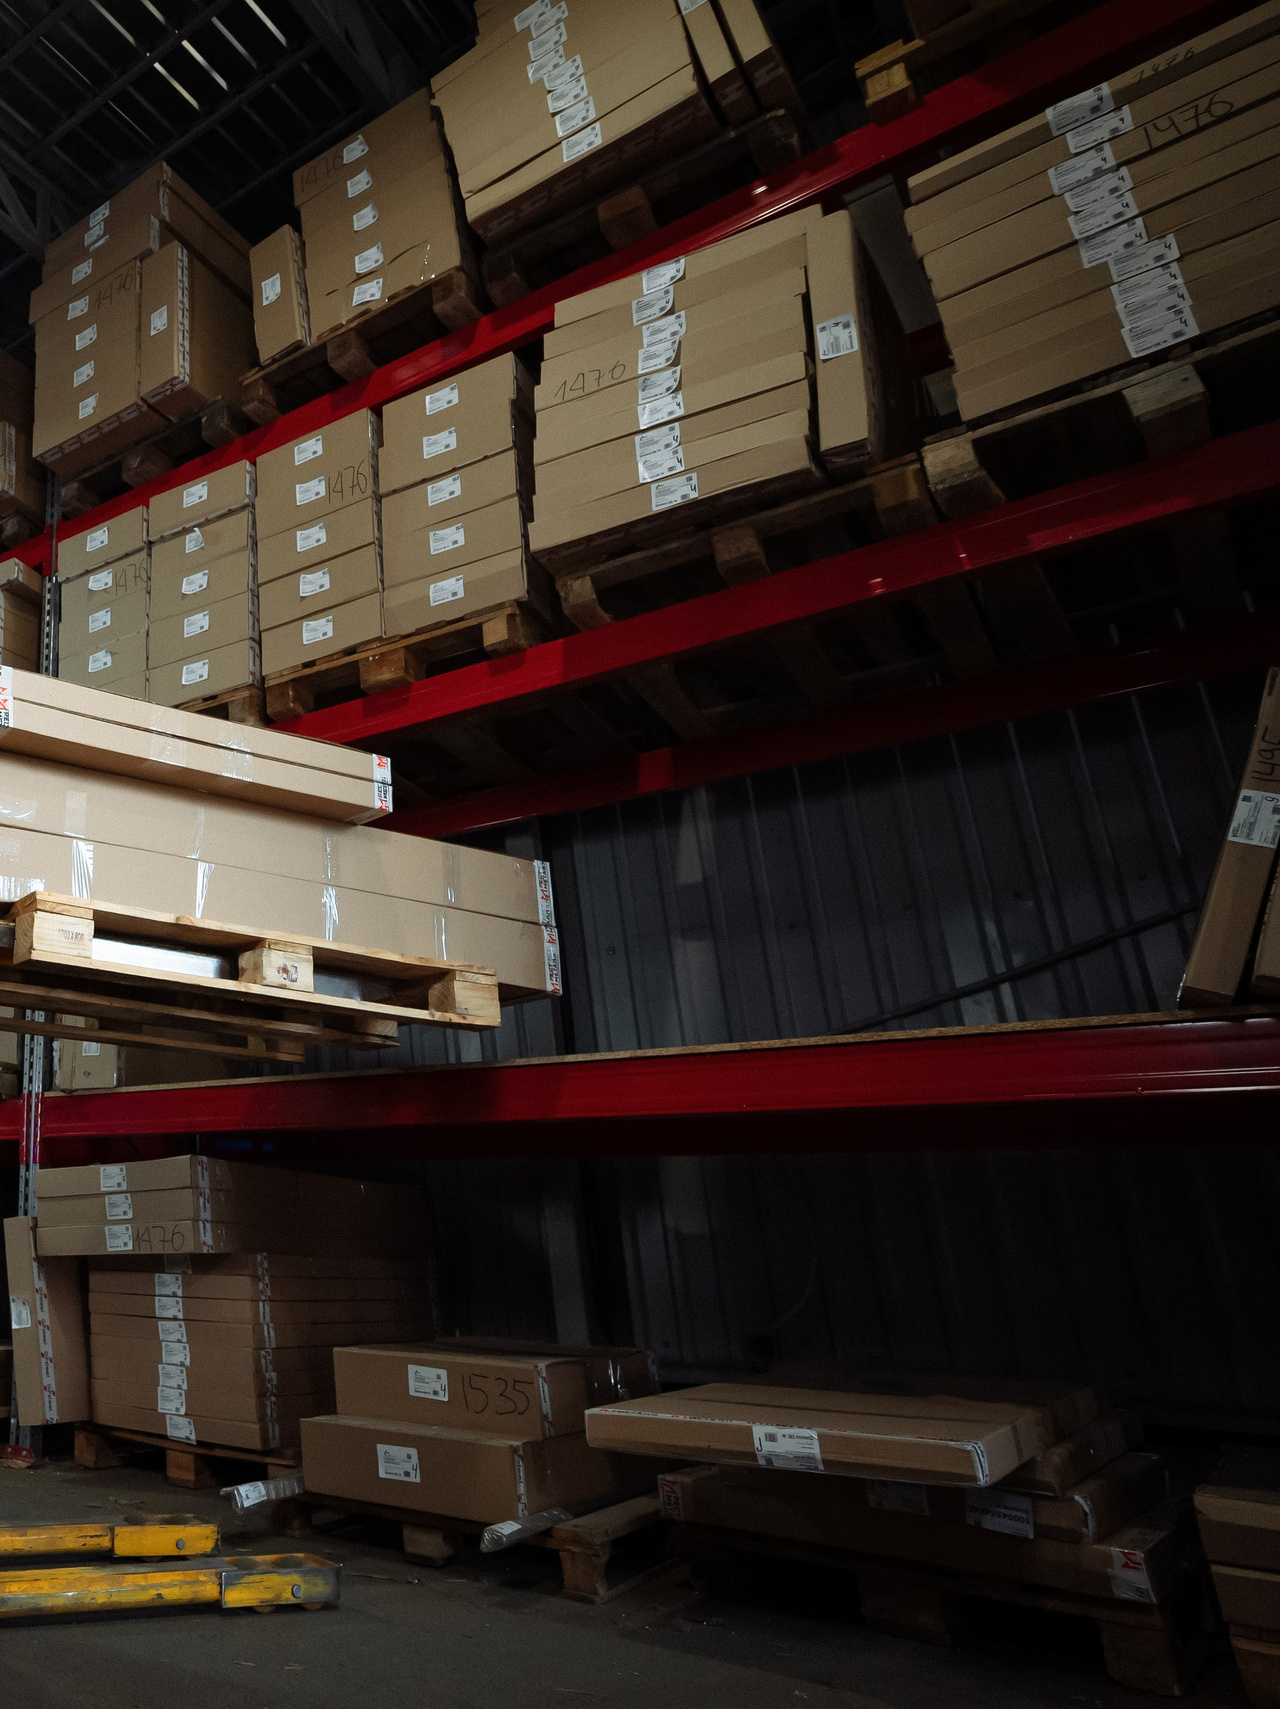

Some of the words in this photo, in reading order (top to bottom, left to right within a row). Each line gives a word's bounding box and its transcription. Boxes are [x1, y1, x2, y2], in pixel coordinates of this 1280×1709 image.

[1143, 92, 1234, 151] 1476
[554, 359, 626, 401] 1476
[327, 459, 368, 504] 1476
[135, 1224, 185, 1252] 1476
[440, 1383, 446, 1397] 4
[461, 1373, 535, 1415] 1535
[412, 1463, 418, 1479] 4
